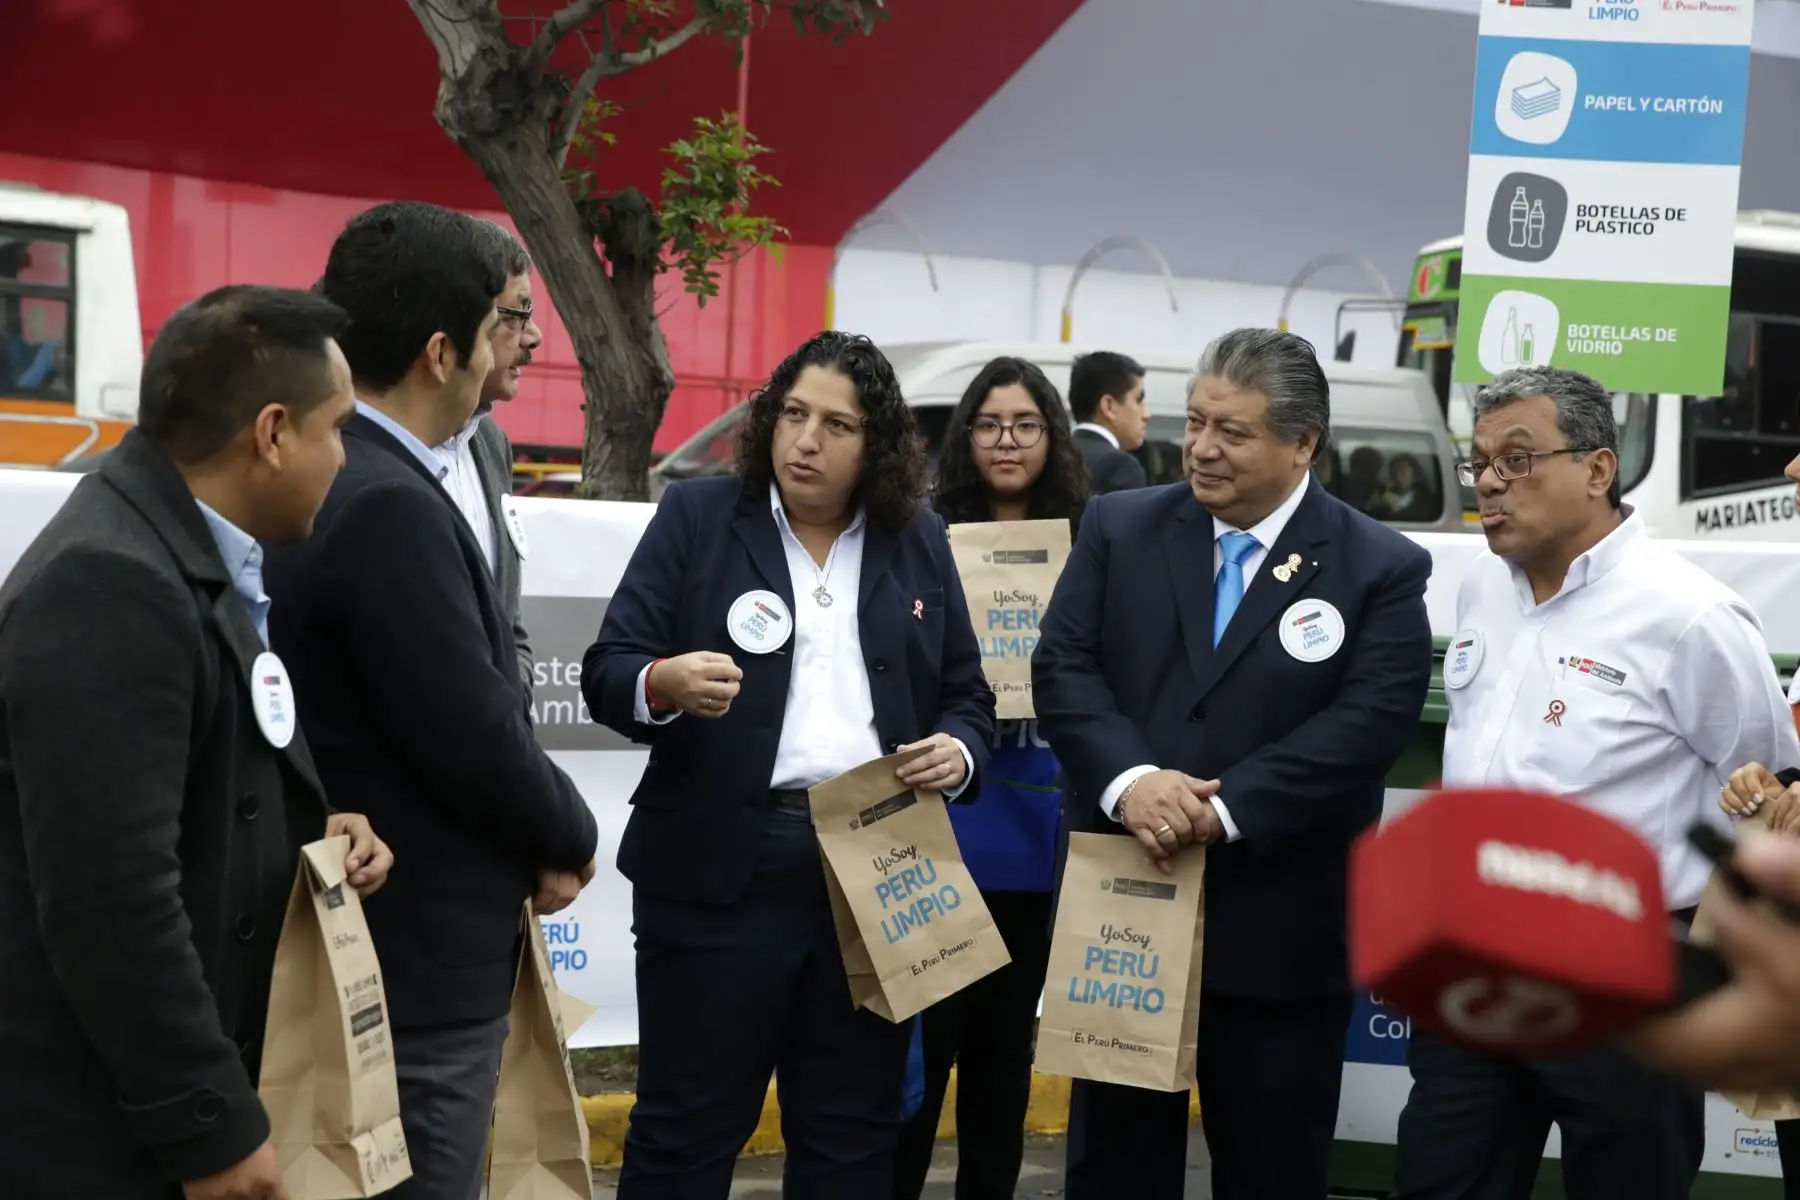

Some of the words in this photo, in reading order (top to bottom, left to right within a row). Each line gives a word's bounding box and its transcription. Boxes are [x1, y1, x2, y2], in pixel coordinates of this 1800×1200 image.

[1588, 6, 1640, 22] LIMPIO
[1584, 94, 1636, 112] PAPEL
[1639, 97, 1651, 111] Y
[1653, 95, 1723, 114] CARTÓN
[1576, 204, 1660, 221] BOTELLAS
[1664, 207, 1687, 222] DE
[1575, 219, 1655, 236] PLASTICO
[1567, 323, 1651, 341] BOTELLAS
[1655, 327, 1678, 342] DE
[1566, 339, 1623, 356] VIDRIO
[1694, 495, 1800, 534] MARIATEG
[875, 856, 937, 909] PERÚ
[880, 883, 962, 944] LIMPIO
[939, 938, 974, 960] PRIMERO
[1084, 945, 1160, 980] PERÚ
[1068, 976, 1165, 1014] LIMPIO
[1074, 1032, 1085, 1044] EL
[1111, 1037, 1149, 1054] PRIMERO
